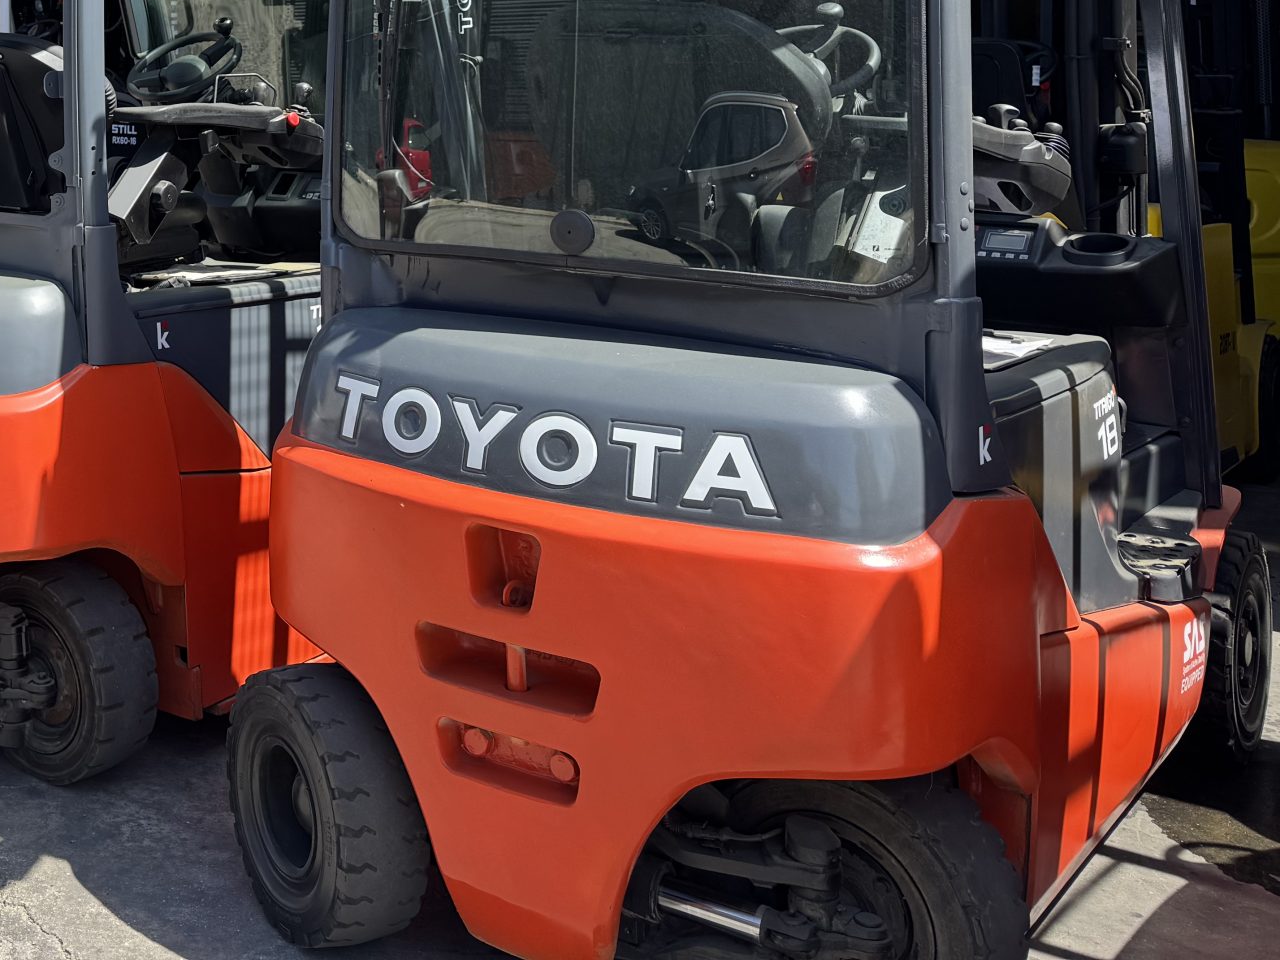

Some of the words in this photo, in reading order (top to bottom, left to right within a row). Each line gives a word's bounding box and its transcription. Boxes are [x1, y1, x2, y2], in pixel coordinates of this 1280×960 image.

[111, 124, 138, 135] STILL
[336, 374, 778, 512] TOYOTA
[1097, 413, 1119, 461] 18
